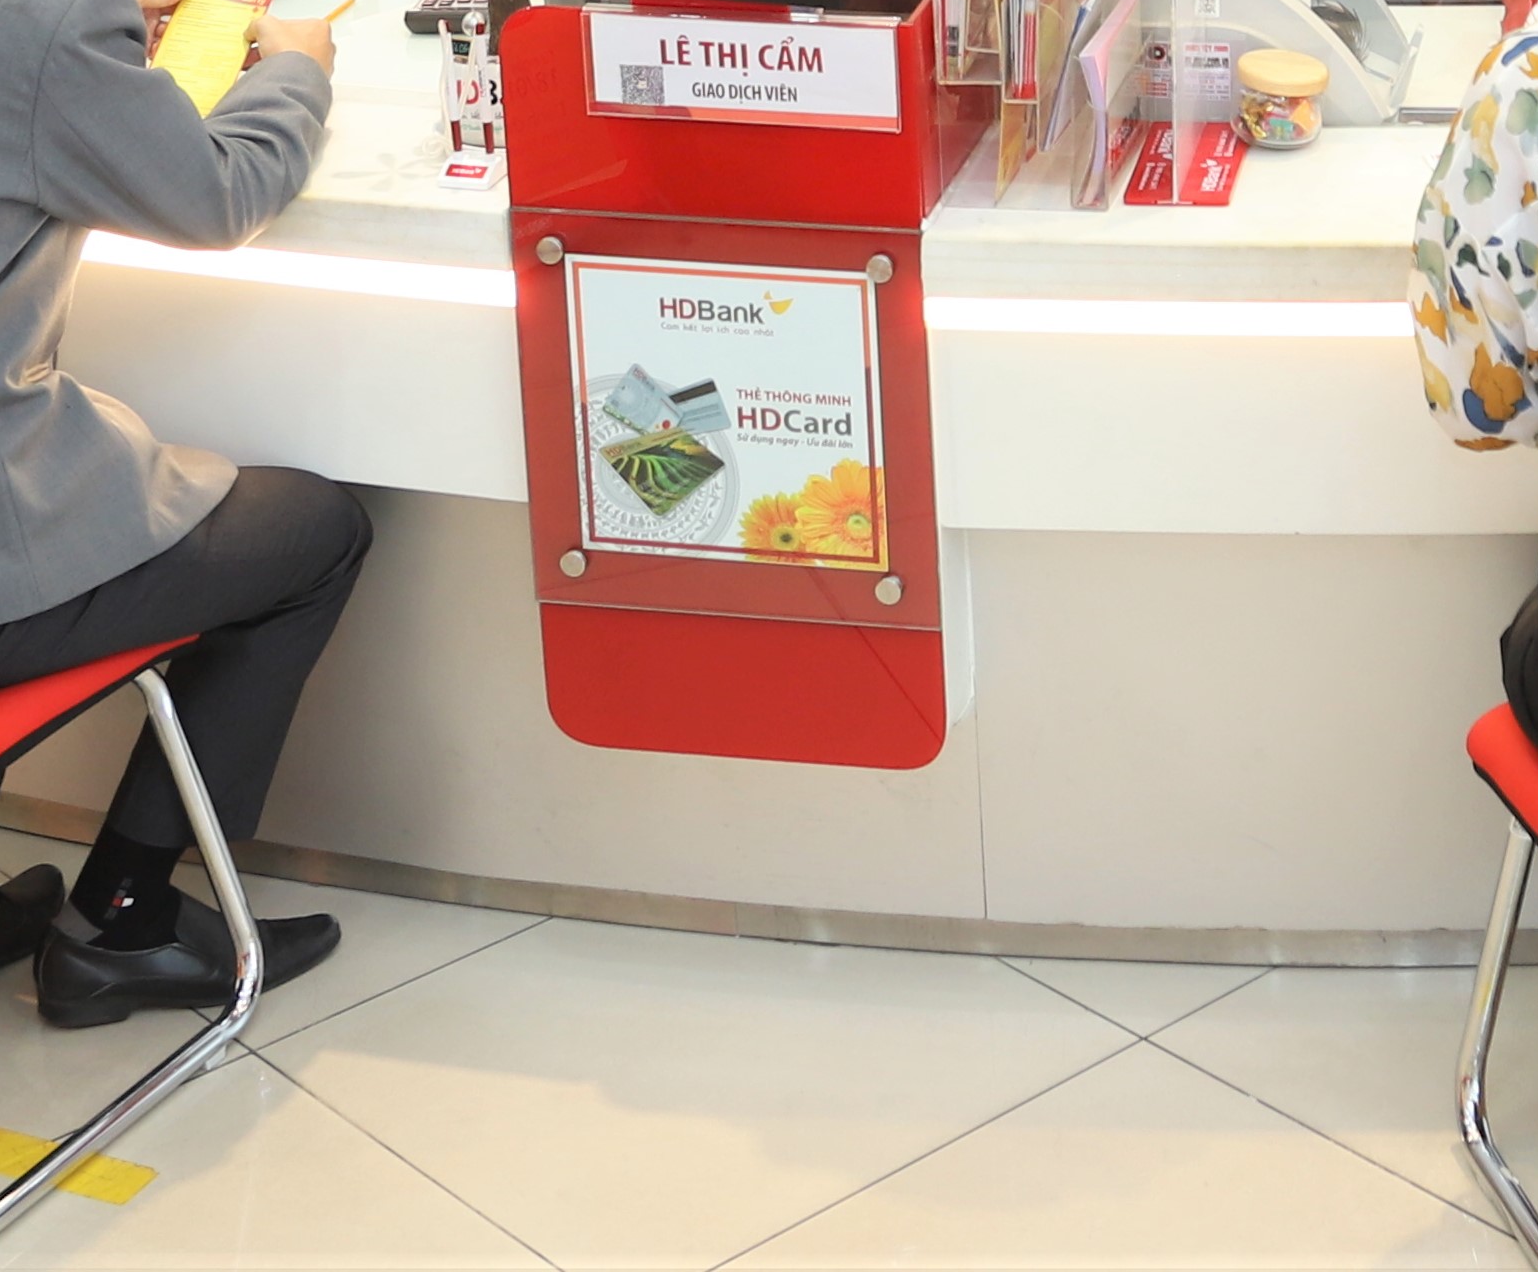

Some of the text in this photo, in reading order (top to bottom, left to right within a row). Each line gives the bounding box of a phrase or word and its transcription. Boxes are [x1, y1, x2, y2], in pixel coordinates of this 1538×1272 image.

[660, 35, 824, 76] LÊ THỊ CẨM
[692, 82, 798, 104] GIAO DỊCH VIÊN
[659, 297, 764, 324] HDBank
[736, 386, 851, 406] THẺ THÔNG MINH
[737, 406, 852, 435] HDCard
[750, 434, 774, 446] dụng
[776, 437, 799, 447] ngay
